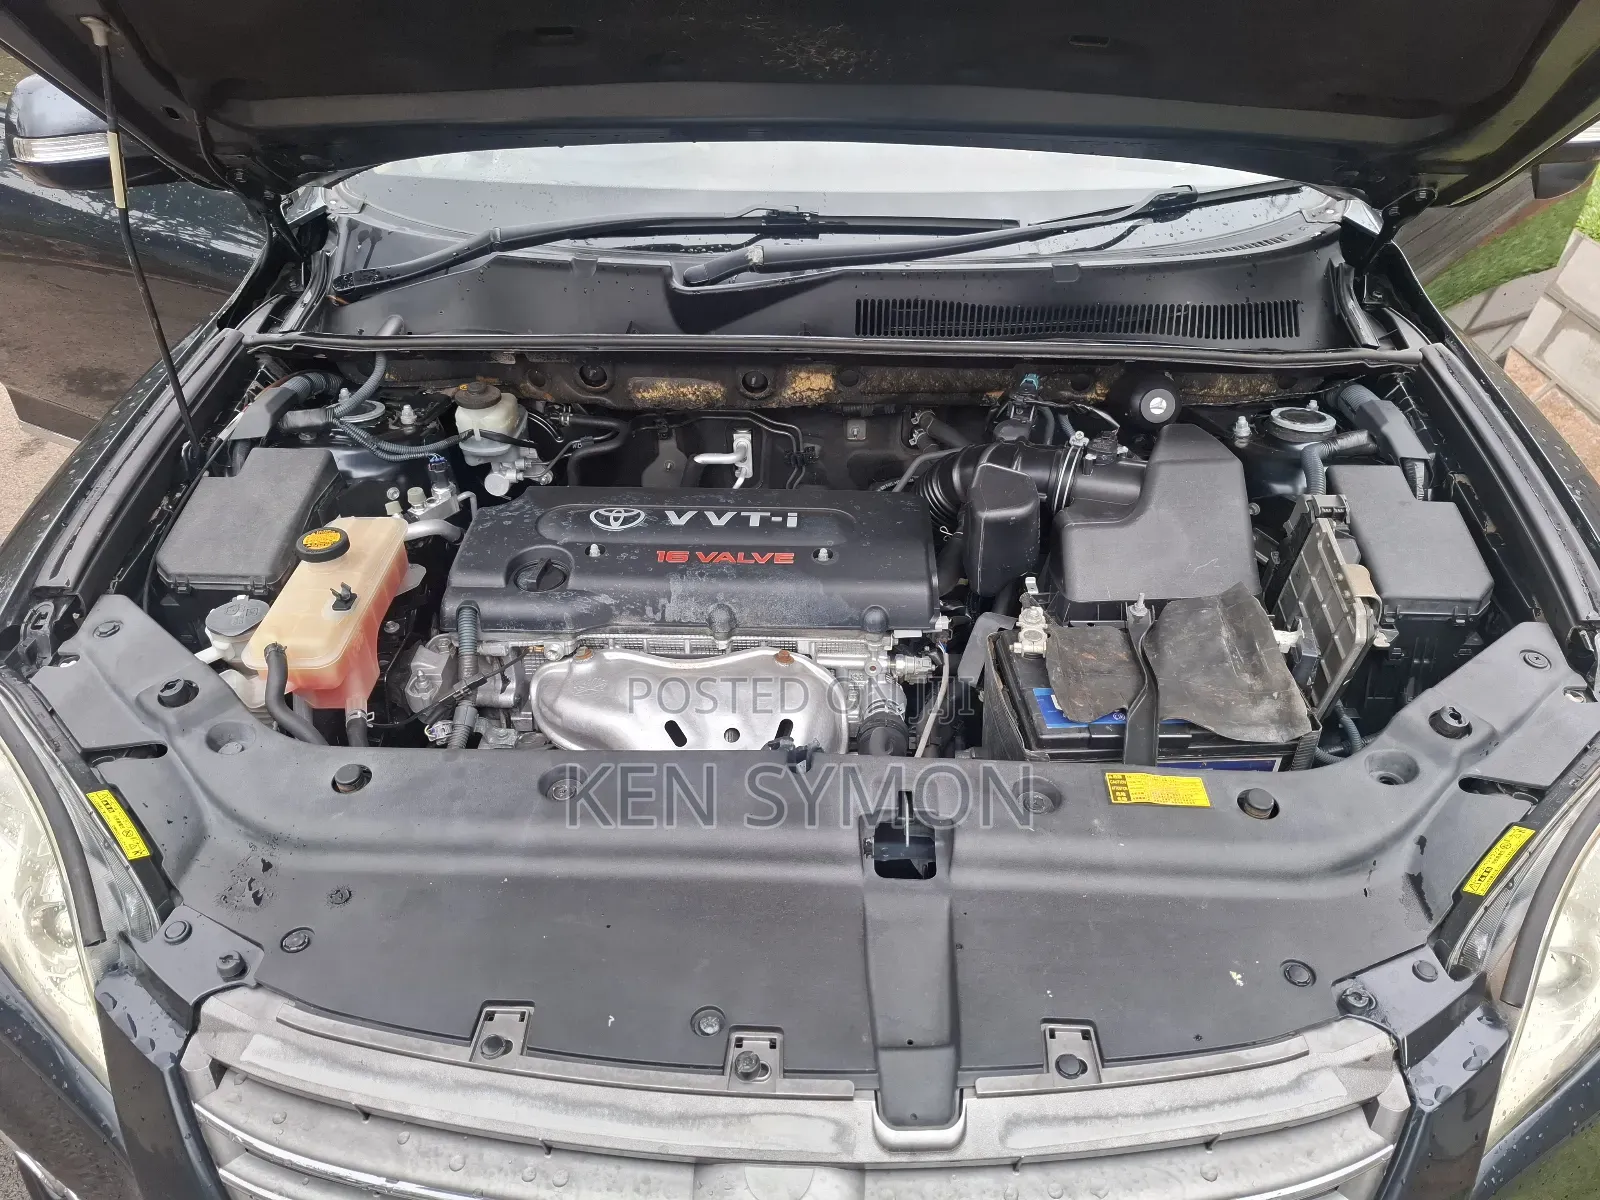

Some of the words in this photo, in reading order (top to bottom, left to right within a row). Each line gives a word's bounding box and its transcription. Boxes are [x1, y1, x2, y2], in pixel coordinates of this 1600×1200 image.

[664, 510, 798, 527] VVT-i
[656, 550, 690, 563] 16
[695, 551, 794, 564] VALVE
